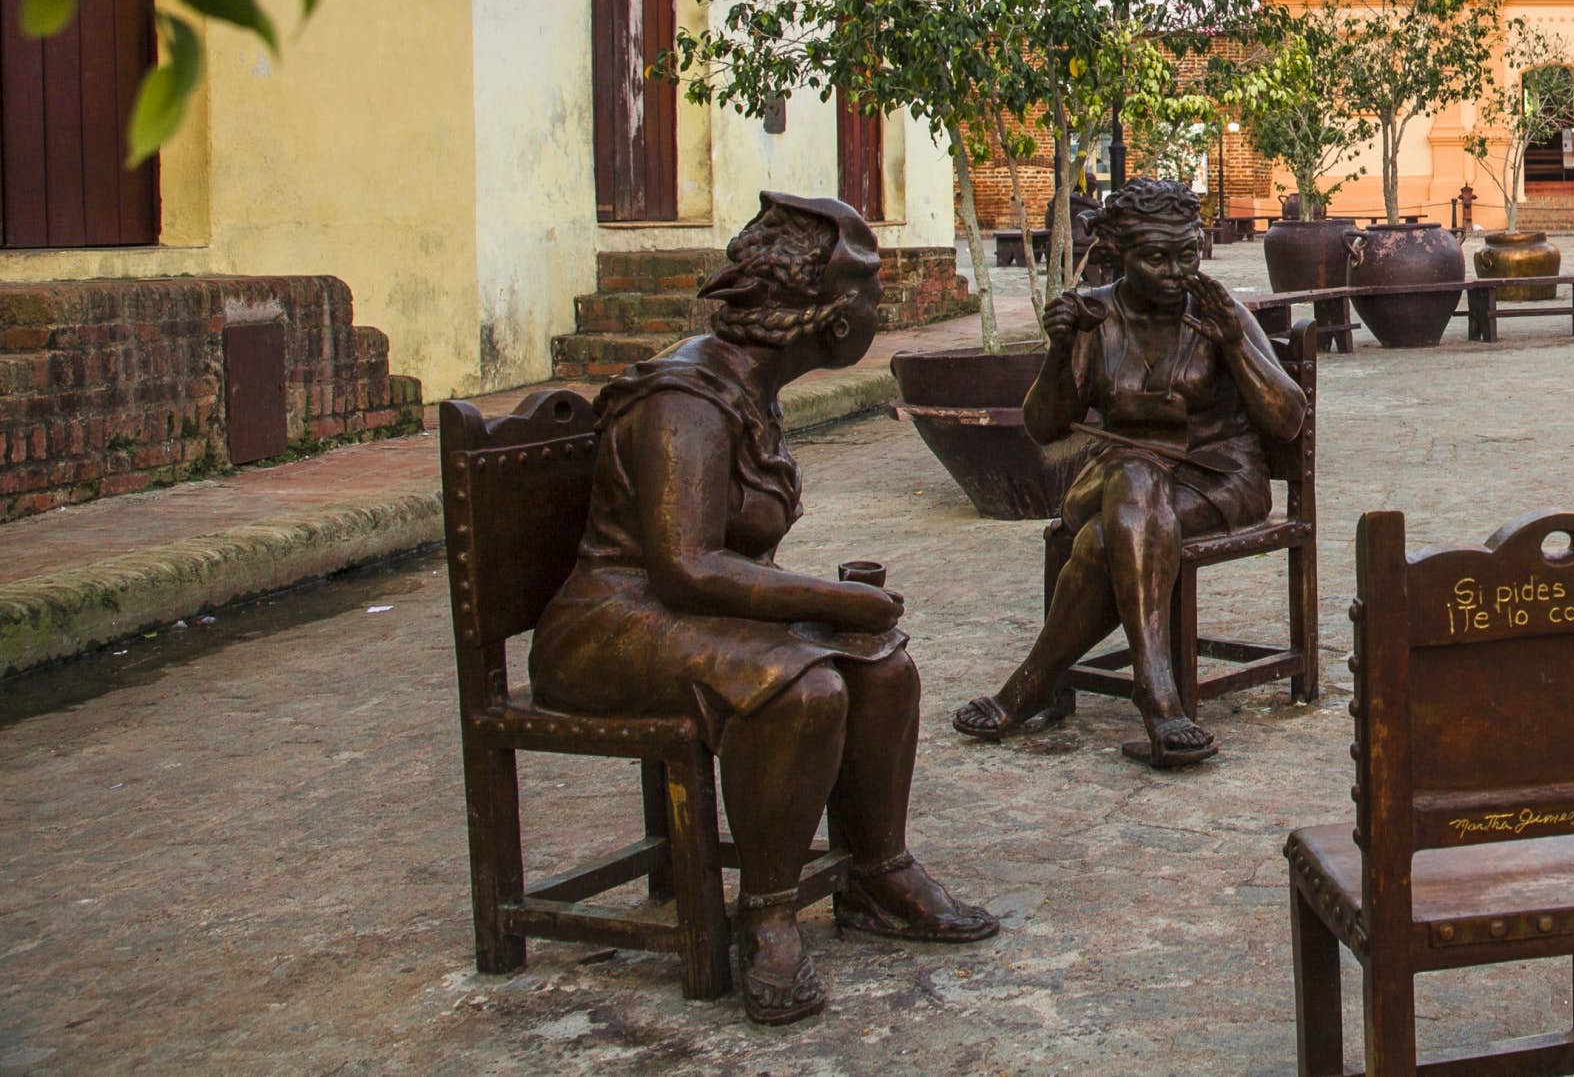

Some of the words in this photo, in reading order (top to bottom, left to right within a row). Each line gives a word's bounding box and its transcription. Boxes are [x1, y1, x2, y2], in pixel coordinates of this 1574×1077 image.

[1454, 577, 1484, 605] Si
[1496, 575, 1566, 613] pides
[1446, 603, 1490, 634] ¡Te
[1507, 605, 1529, 628] lo
